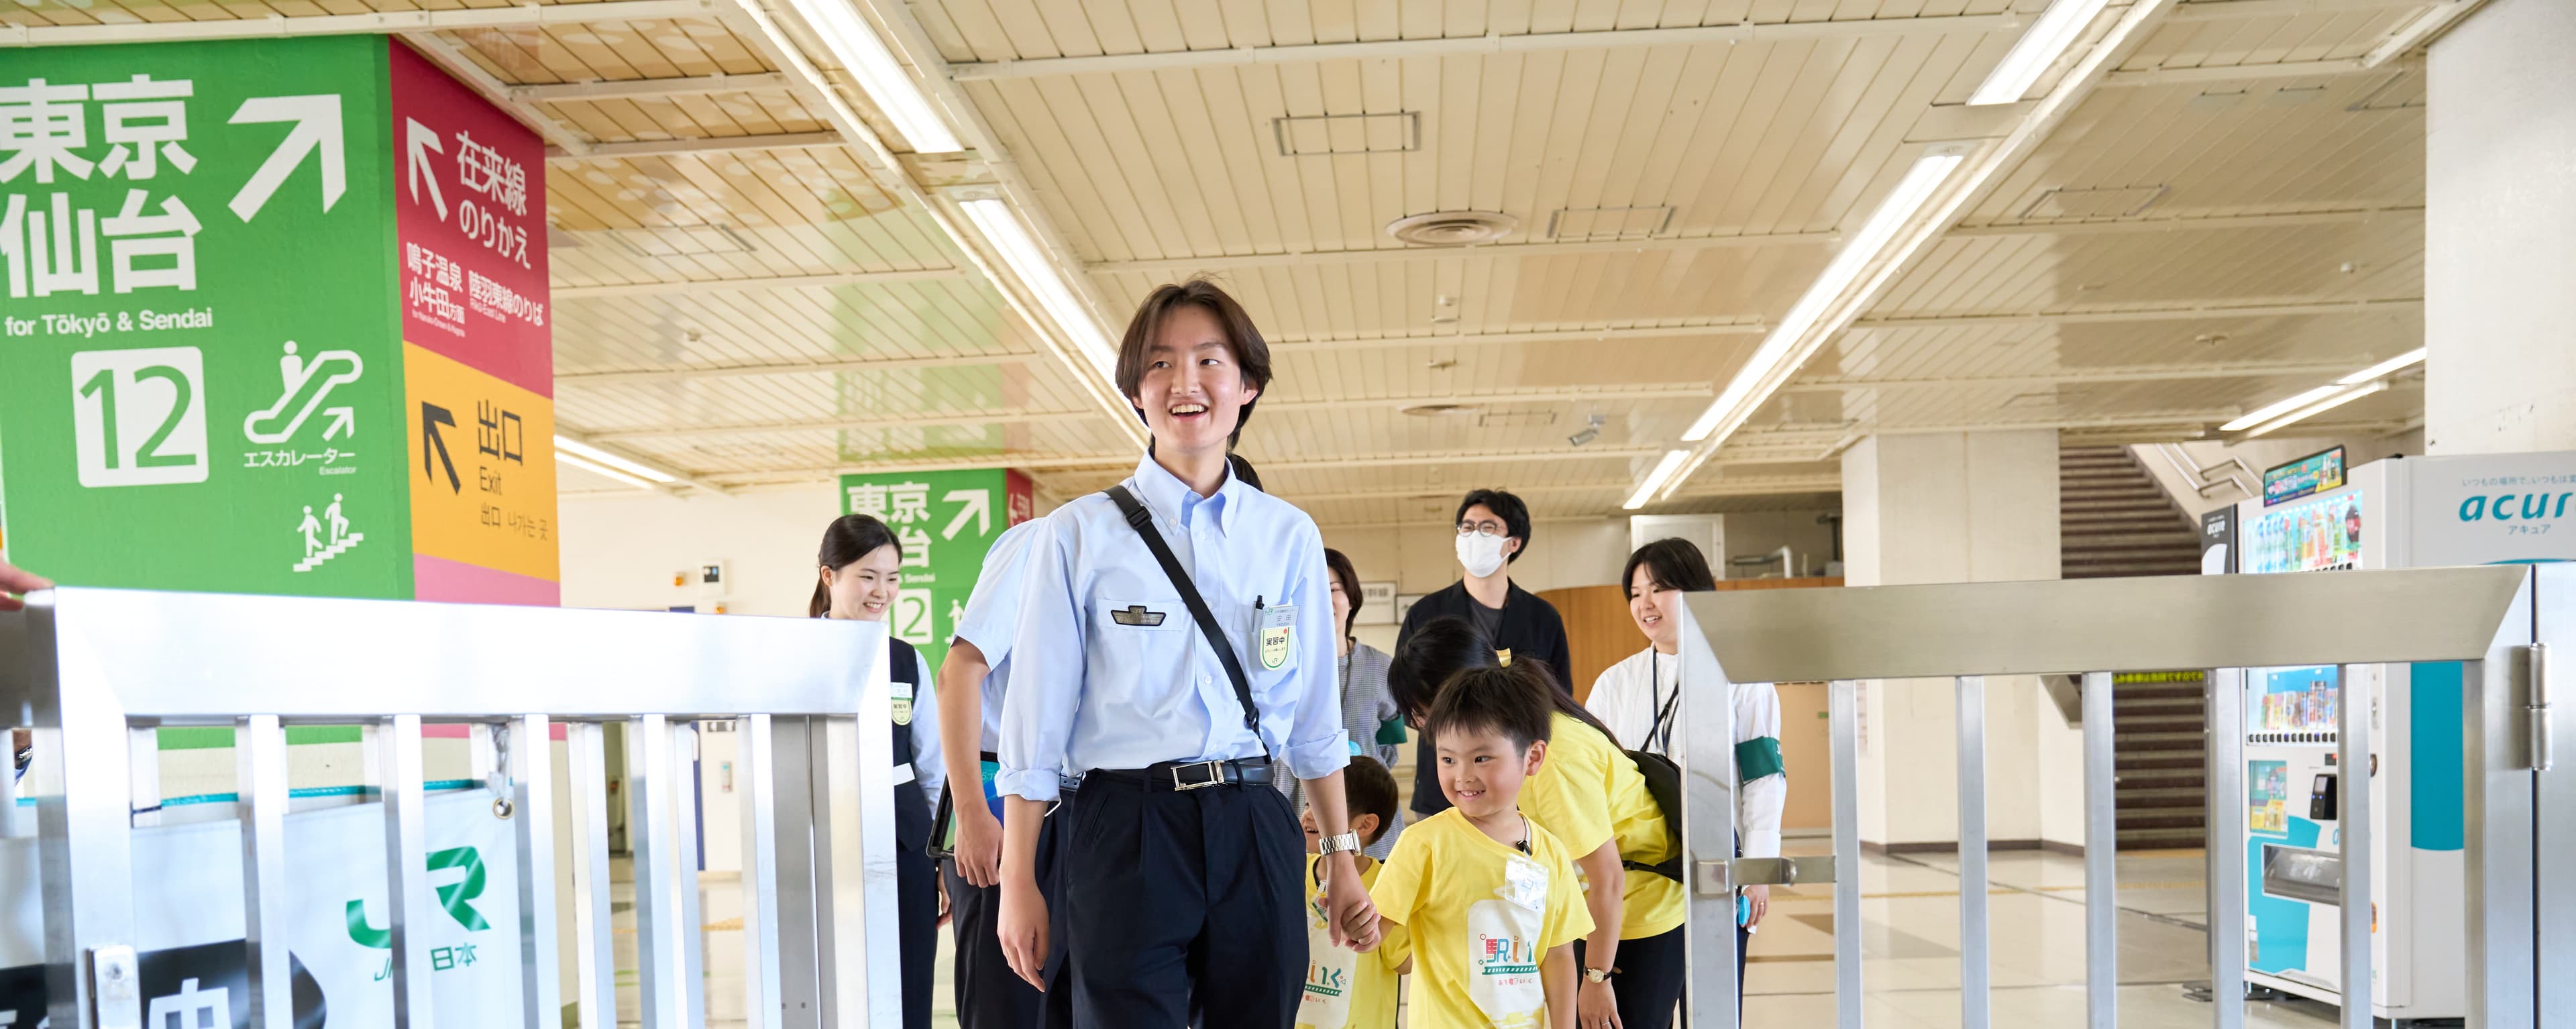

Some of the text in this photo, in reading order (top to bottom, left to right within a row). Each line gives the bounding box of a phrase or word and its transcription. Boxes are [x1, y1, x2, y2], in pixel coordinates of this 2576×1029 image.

[0, 74, 198, 184] 東京
[456, 130, 527, 216] 在来線
[0, 188, 203, 298] 仙台
[459, 199, 531, 270] のりかえ
[407, 241, 463, 293] 鳴子温泉
[468, 269, 543, 327] 陸羽東線のりば
[5, 307, 213, 338] for Tōkyō & Sendai
[80, 365, 197, 469] 12
[478, 399, 523, 466] 出口
[244, 447, 356, 468] エスカレーター
[319, 466, 357, 476] Escalator
[480, 466, 502, 495] Exit
[481, 502, 501, 526] 出口
[847, 481, 931, 525] 東京
[508, 512, 535, 539] 나가는
[2508, 524, 2551, 535] アキュア
[1266, 637, 1285, 647] 実習中
